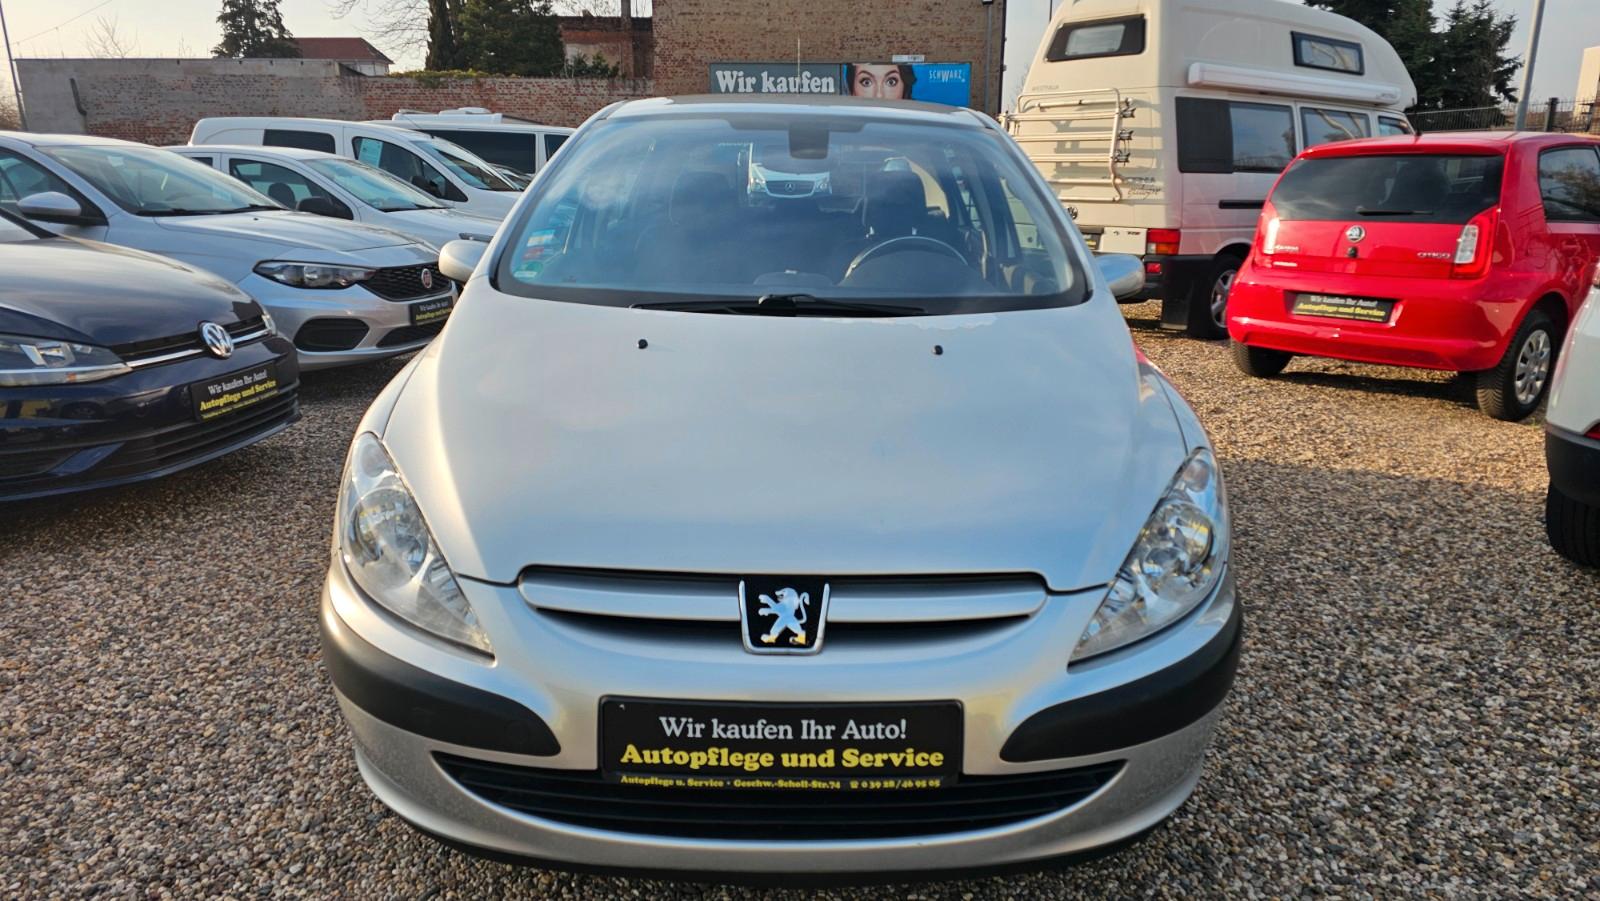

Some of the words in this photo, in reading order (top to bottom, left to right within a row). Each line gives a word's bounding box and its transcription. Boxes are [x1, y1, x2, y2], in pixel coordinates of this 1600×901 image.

[716, 70, 756, 93] Wir
[761, 70, 835, 93] kaufen
[929, 69, 962, 82] SCHWARZ
[658, 716, 705, 738] Wir
[711, 718, 794, 740] kaufen
[800, 719, 836, 740] Ihr
[841, 718, 907, 740] Auto!
[620, 743, 775, 772] Autopflege
[780, 748, 835, 768] und
[841, 747, 945, 768] Service
[620, 775, 674, 787] Autopflege
[675, 779, 686, 787] u.
[687, 778, 724, 788] Service
